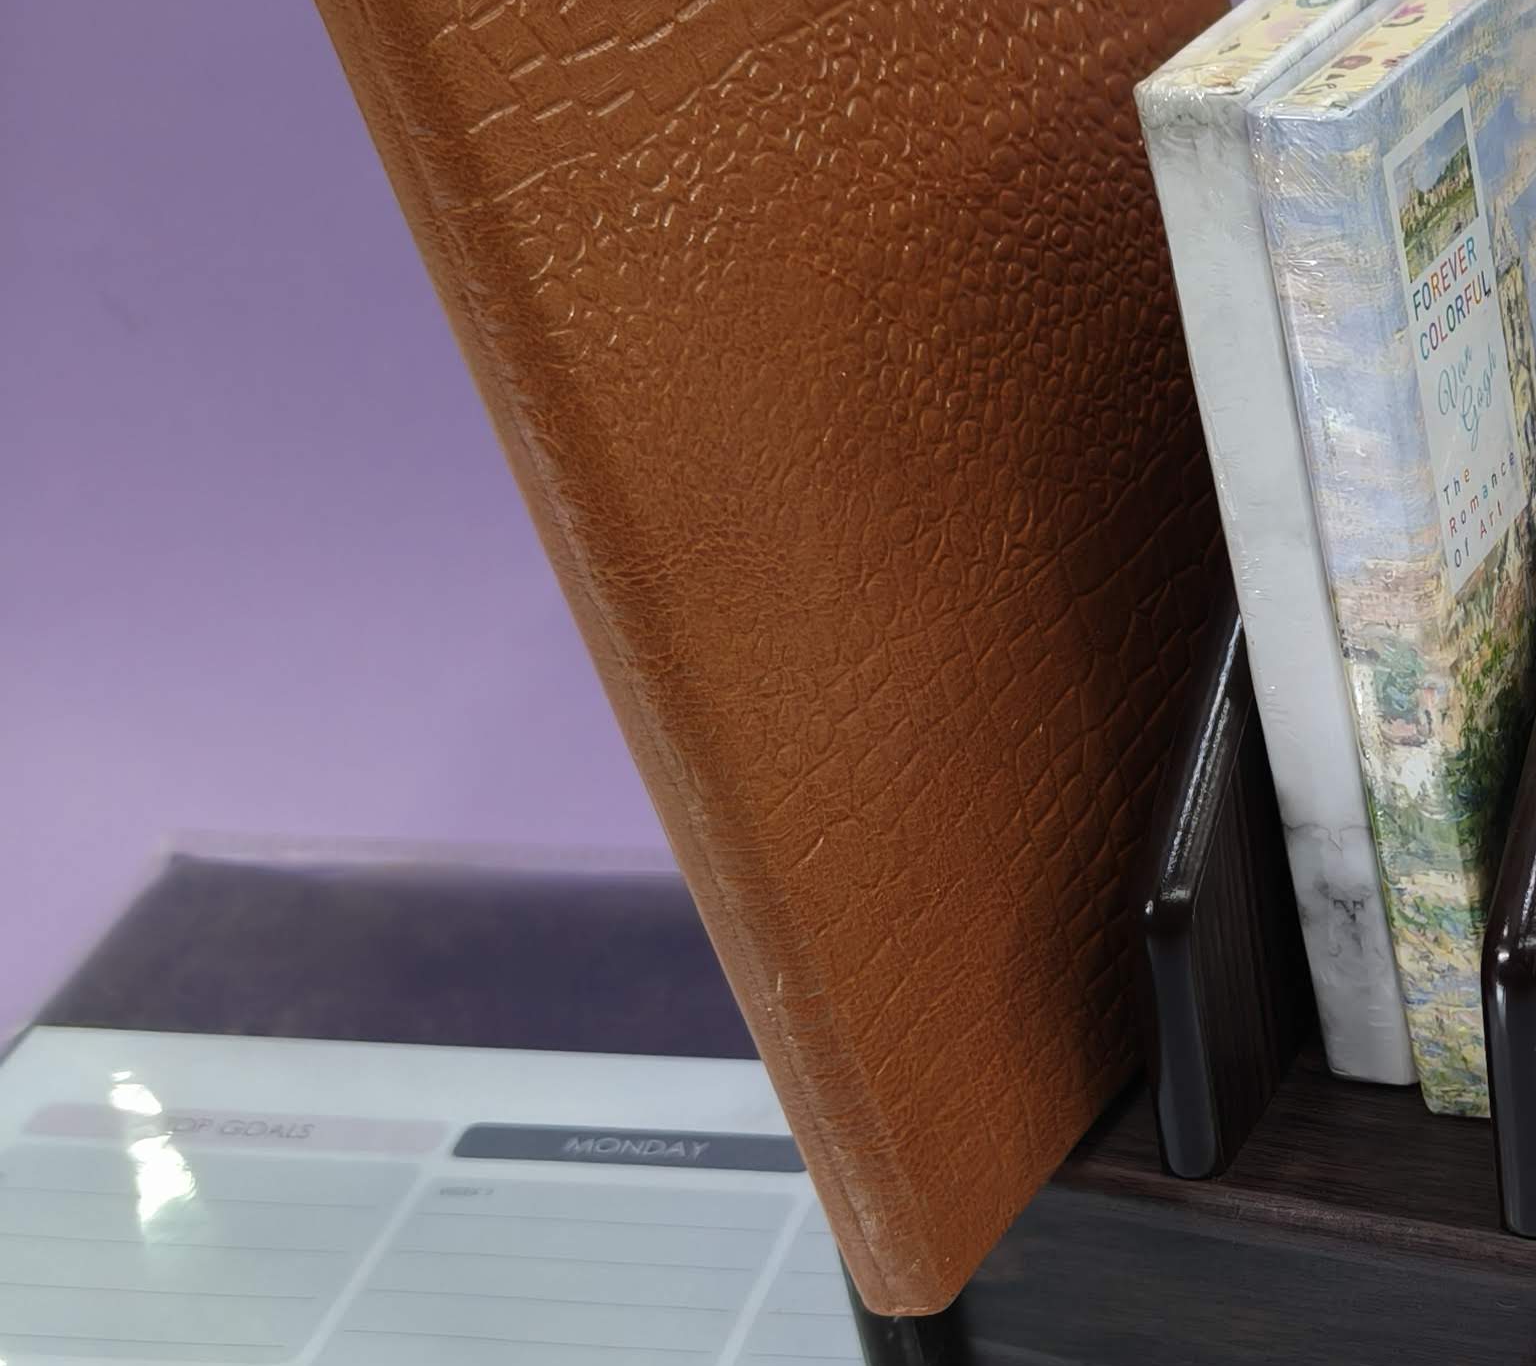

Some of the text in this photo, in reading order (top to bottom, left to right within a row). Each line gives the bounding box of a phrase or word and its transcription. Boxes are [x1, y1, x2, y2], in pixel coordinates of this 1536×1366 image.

[1411, 236, 1478, 322] FOREVER
[1419, 270, 1492, 361] COLORFUL
[1442, 467, 1471, 506] The
[1449, 451, 1516, 538] Romance
[1479, 500, 1503, 539] Art
[218, 1119, 316, 1141] GOALS
[562, 1136, 711, 1160] MONDAY
